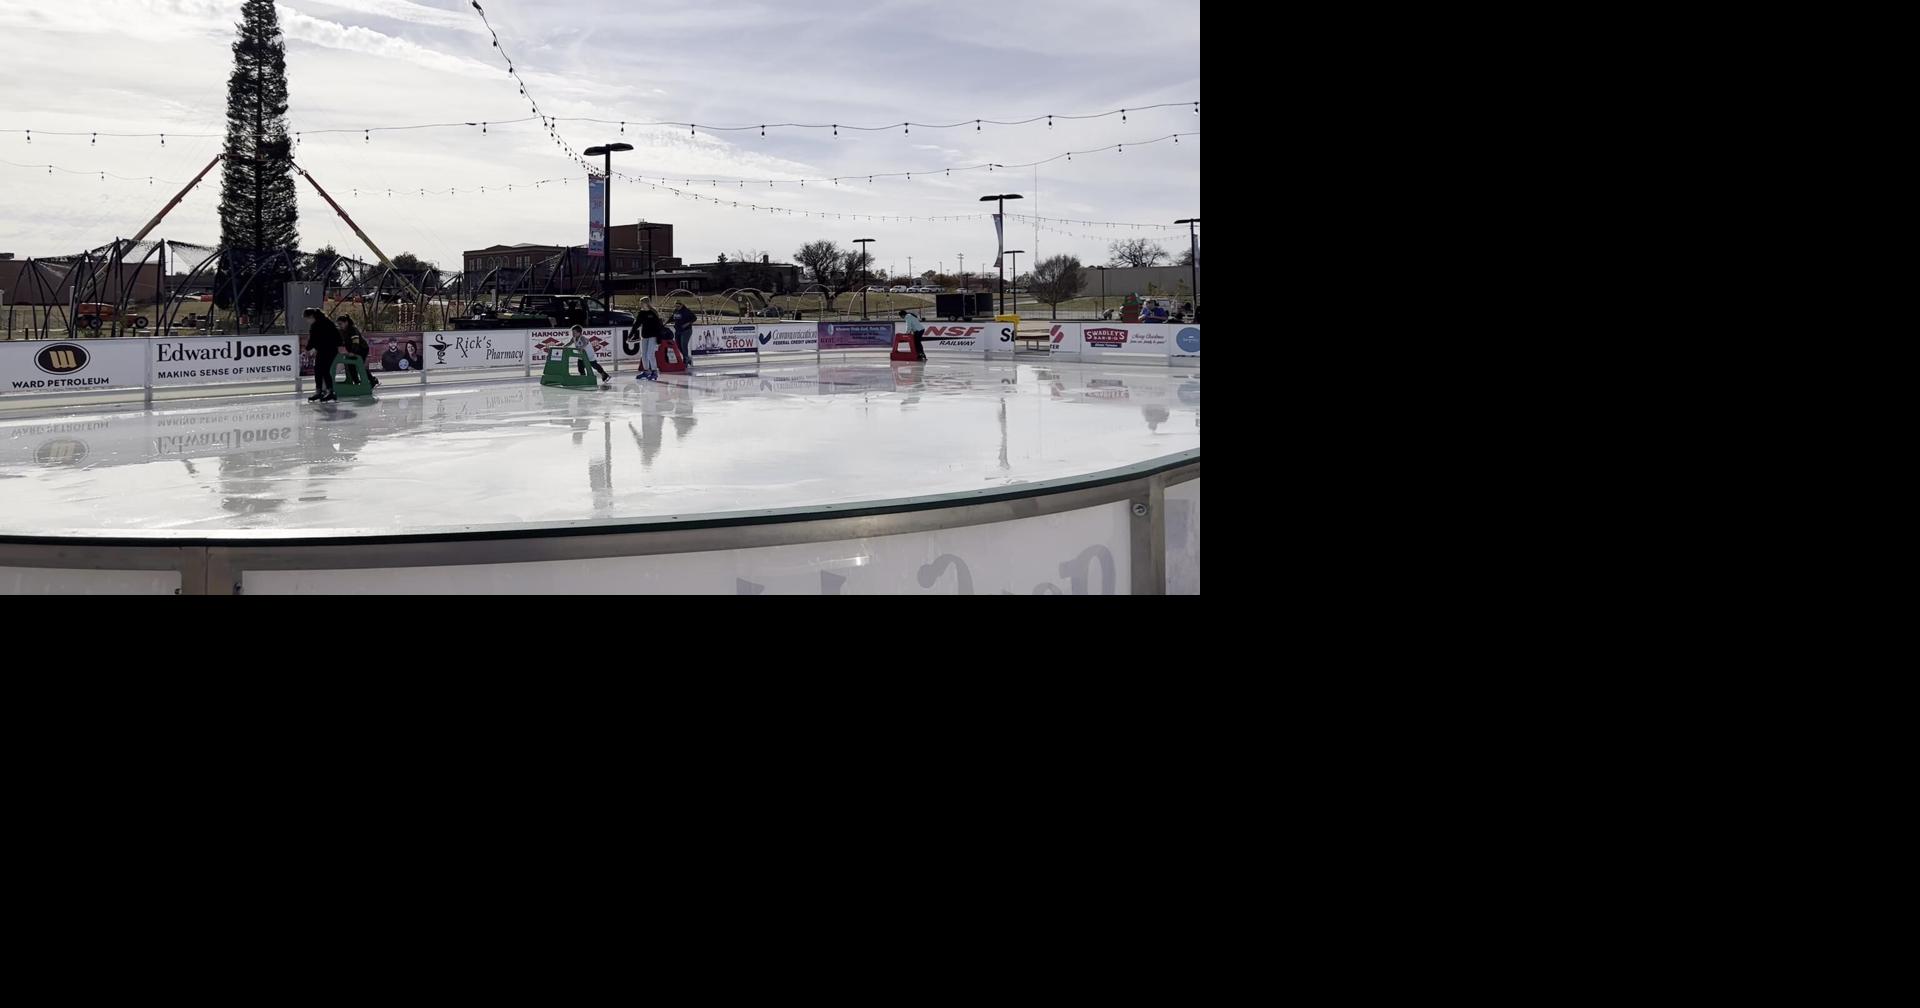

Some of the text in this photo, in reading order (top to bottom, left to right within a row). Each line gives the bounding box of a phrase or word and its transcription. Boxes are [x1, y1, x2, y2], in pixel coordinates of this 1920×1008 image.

[582, 329, 612, 337] ARMON'S
[923, 326, 984, 337] NSF
[455, 335, 492, 358] Rick's
[726, 339, 754, 348] GROW
[156, 340, 233, 362] Edward
[234, 340, 293, 361] Jones
[486, 348, 524, 362] Pharmacy
[158, 364, 292, 379] MAKING SENSE OF INVESTING
[12, 377, 110, 389] WARD PETROLEUM
